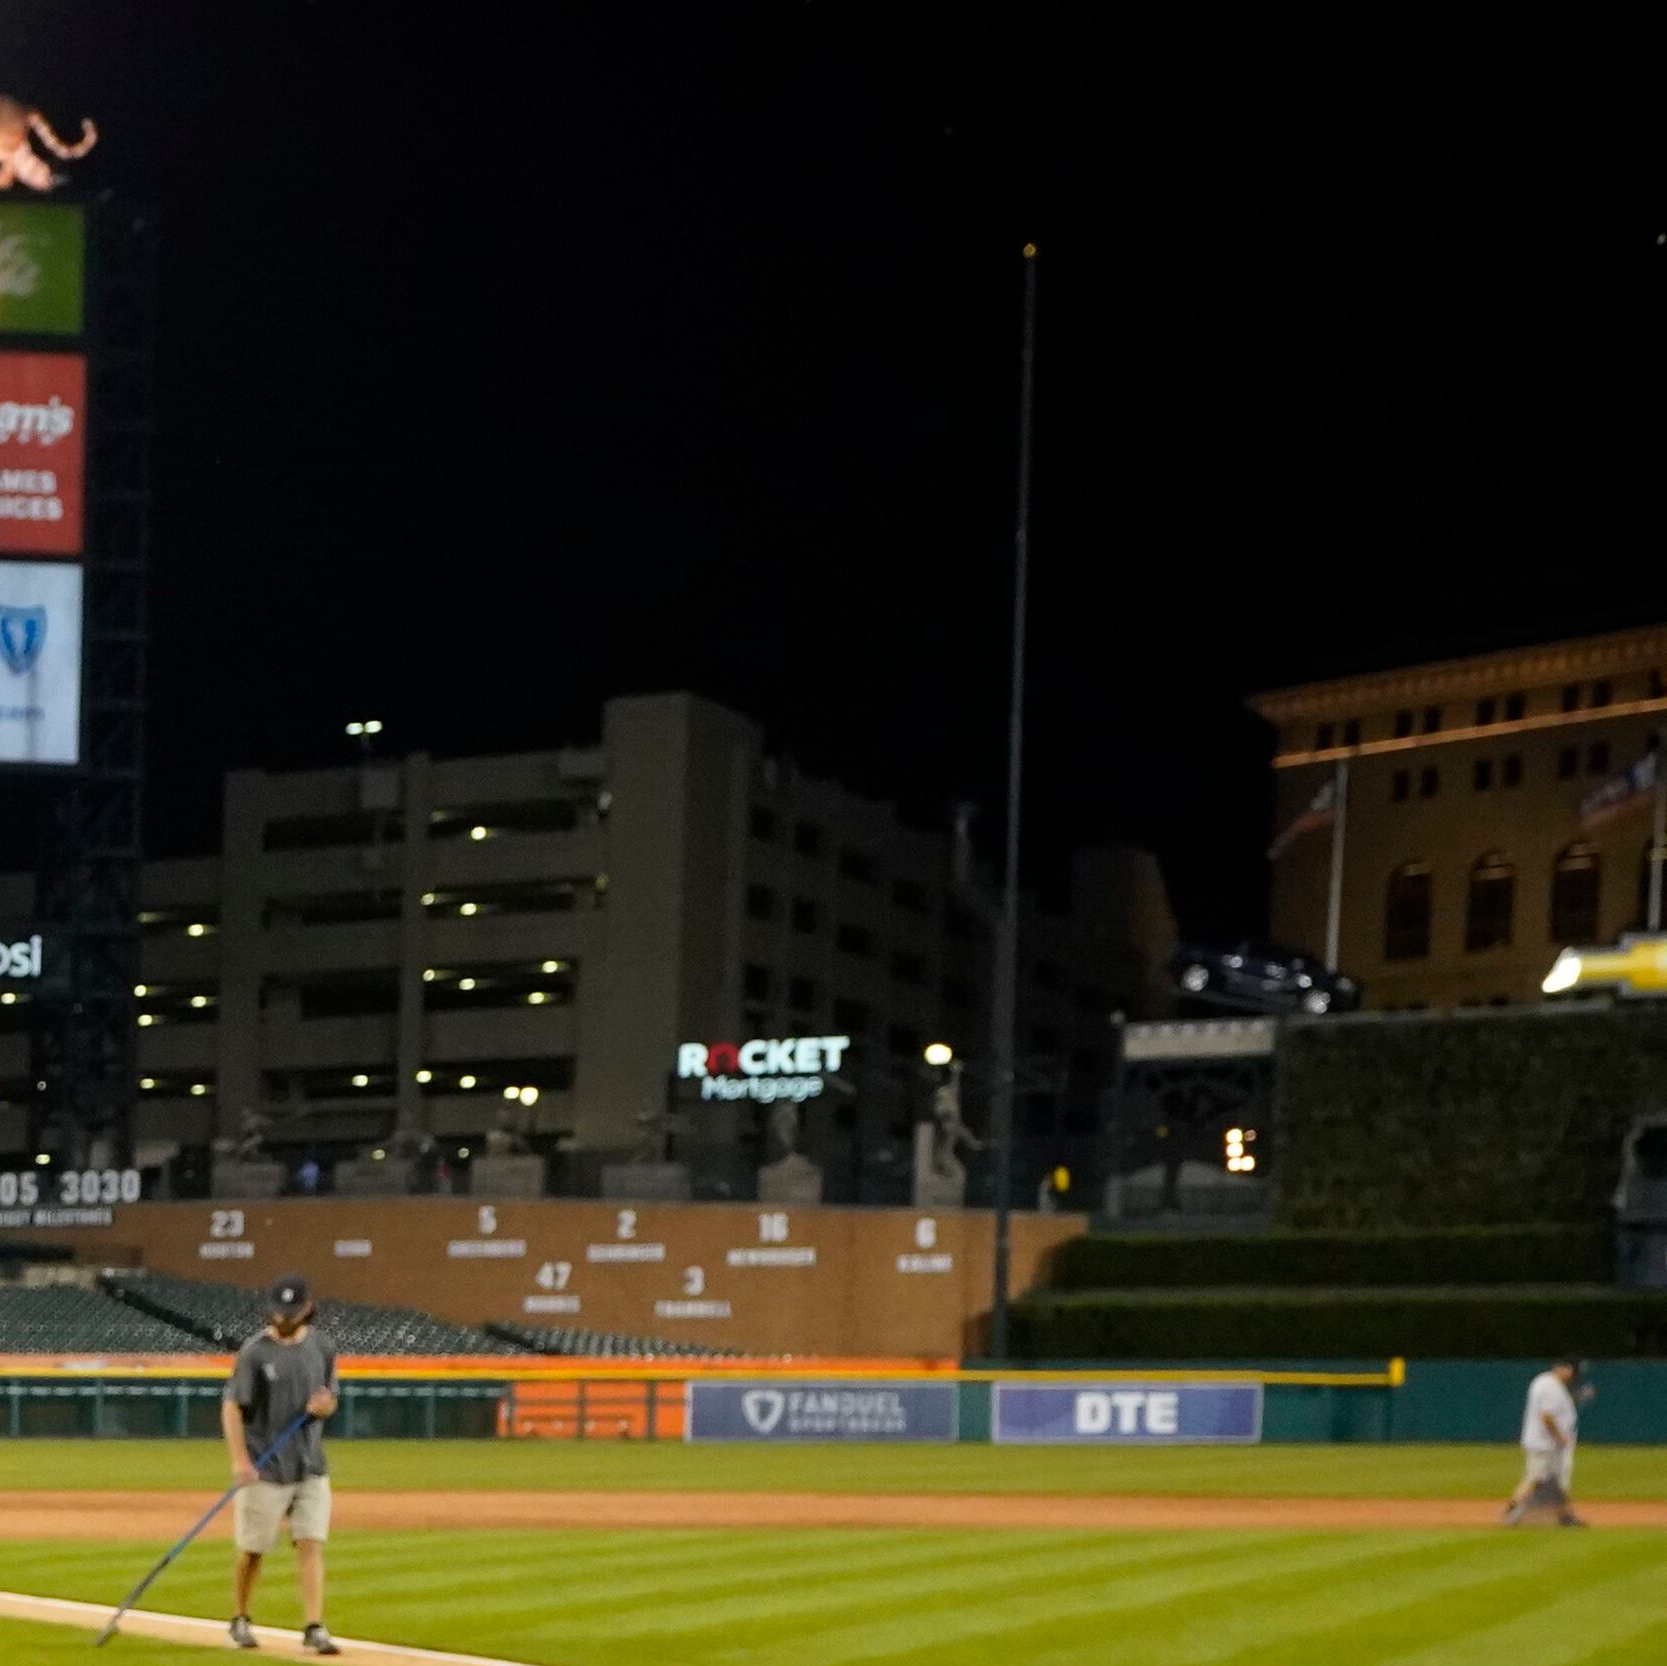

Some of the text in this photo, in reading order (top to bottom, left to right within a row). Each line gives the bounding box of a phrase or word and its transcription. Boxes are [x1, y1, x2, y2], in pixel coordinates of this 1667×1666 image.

[701, 1074, 824, 1104] Mortgage
[210, 1210, 245, 1238] 23
[618, 1208, 637, 1239] 2
[535, 1261, 573, 1290] 47
[683, 1265, 705, 1296] 3
[1075, 1391, 1179, 1434] DTE
